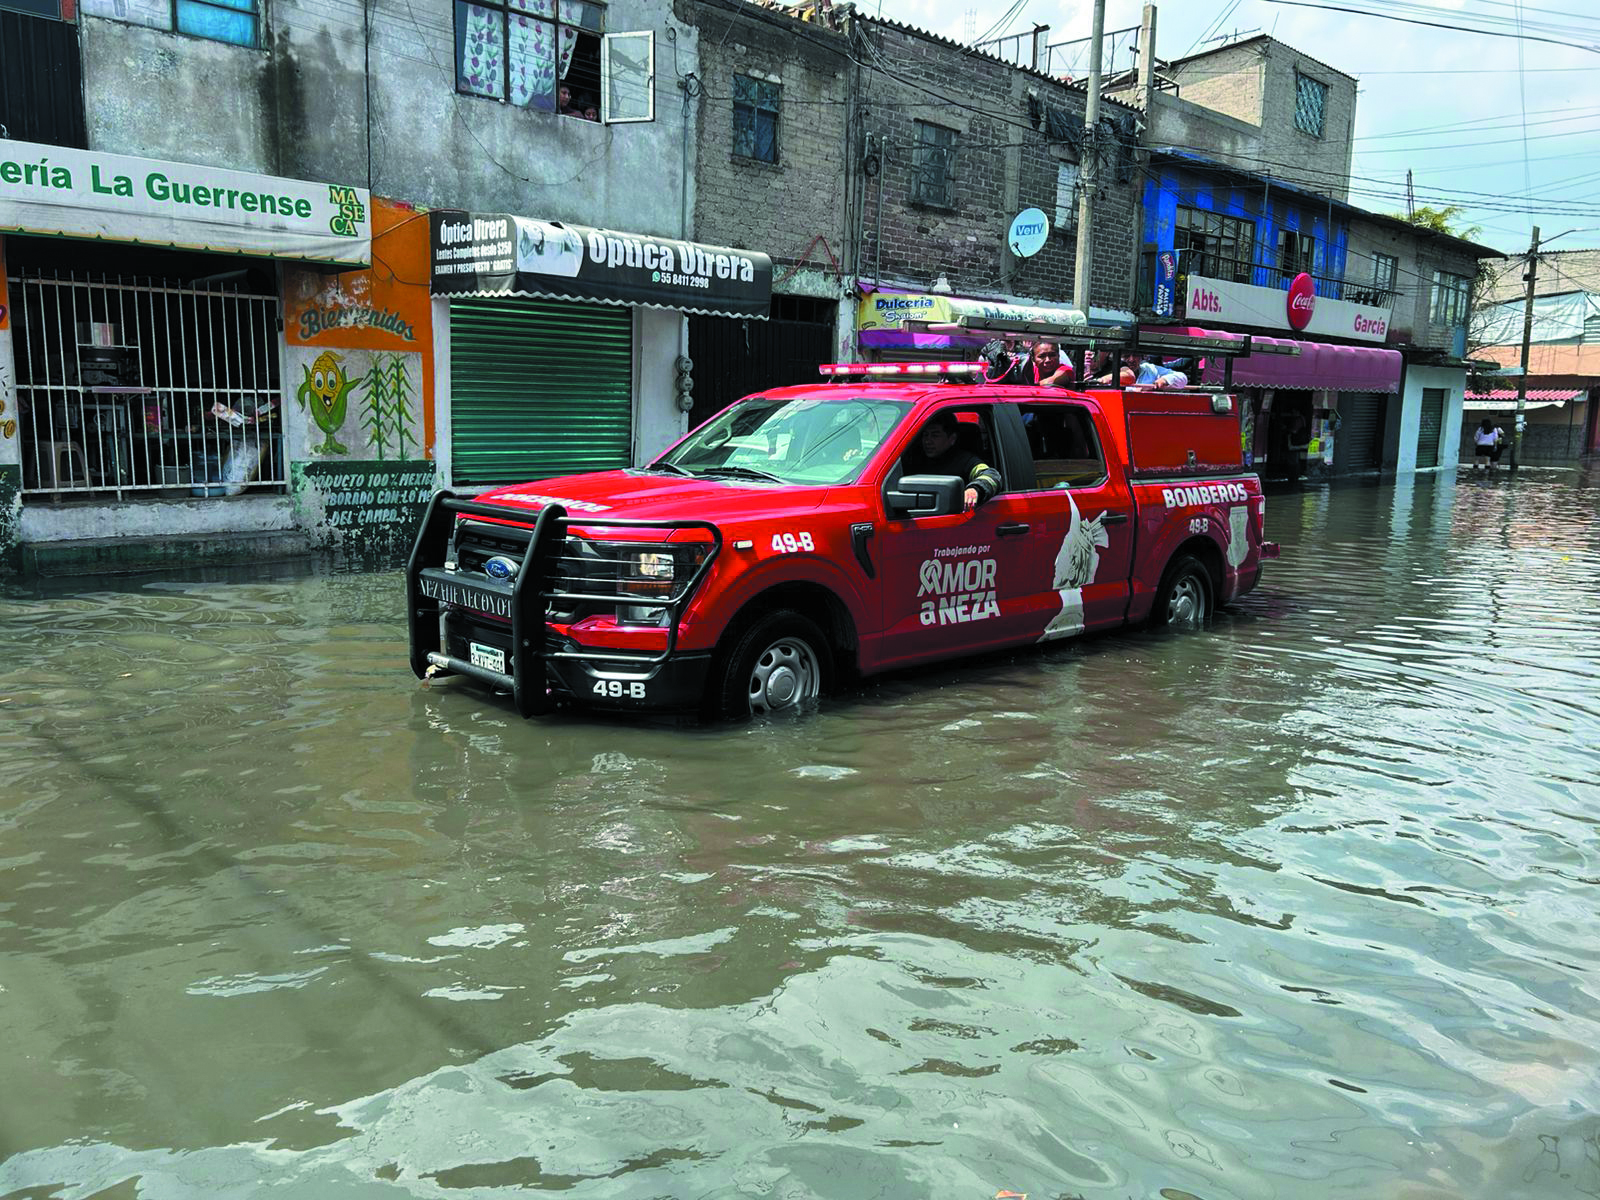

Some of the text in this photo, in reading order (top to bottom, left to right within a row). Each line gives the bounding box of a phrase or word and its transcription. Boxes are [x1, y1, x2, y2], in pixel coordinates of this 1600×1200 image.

[1, 158, 312, 218] ería La Guerrense
[440, 219, 508, 246] Óptica Utrera
[678, 244, 754, 282] Utrera
[661, 271, 709, 289] 55 8411 2998
[1192, 287, 1222, 312] Abts.
[298, 306, 417, 342] Bienenidos
[1354, 313, 1386, 336] García
[377, 489, 400, 505] CON
[417, 489, 432, 503] ME
[1162, 483, 1249, 508] BOMBEROS
[331, 510, 353, 527] DEL
[1189, 517, 1209, 535] 49-B
[771, 531, 816, 554] 49-B
[934, 544, 992, 559] Trabajando por
[917, 559, 998, 597] AMOR
[920, 590, 1001, 626] a NEZA
[593, 680, 647, 699] 49-B
